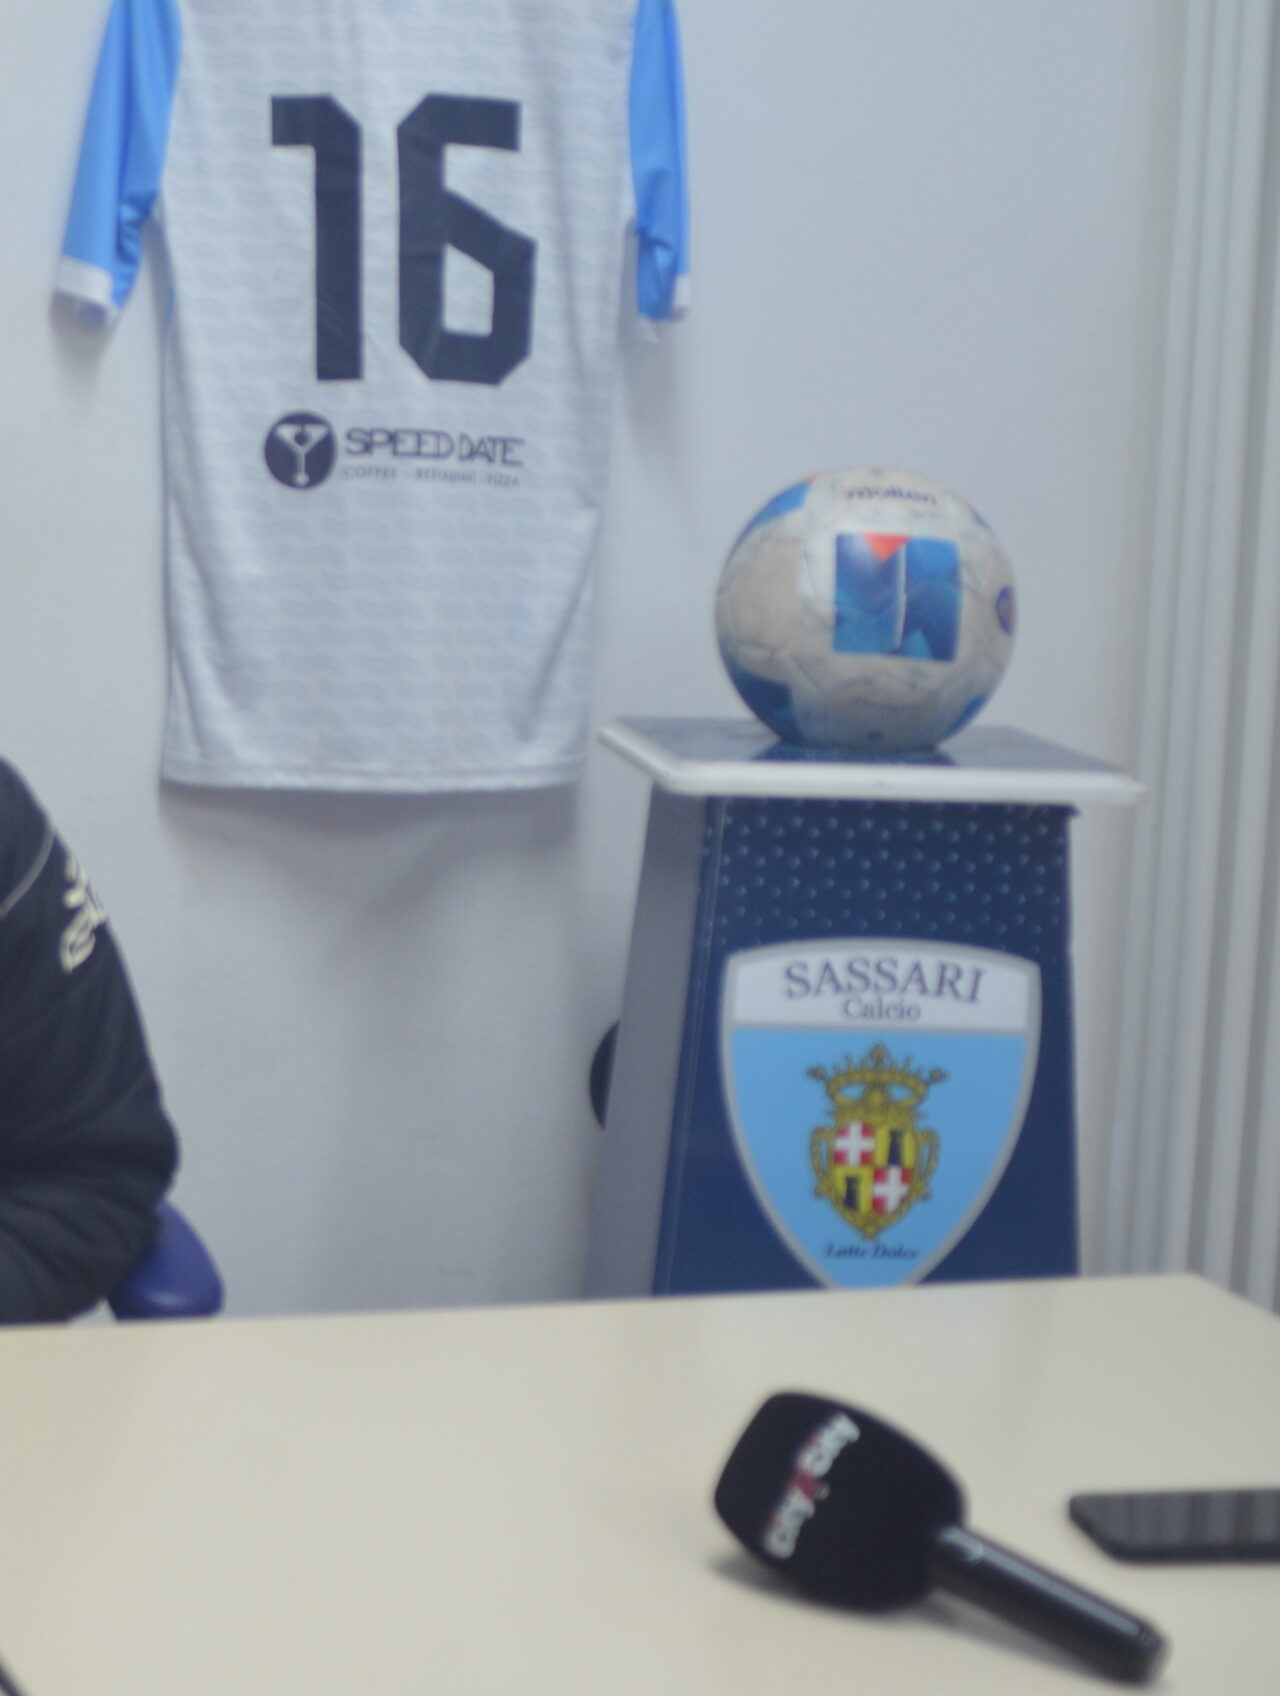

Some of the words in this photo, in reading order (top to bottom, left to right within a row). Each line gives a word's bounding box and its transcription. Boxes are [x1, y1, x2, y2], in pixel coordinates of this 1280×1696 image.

[271, 92, 538, 386] 16
[344, 427, 455, 460] SPEED
[458, 432, 526, 468] DATE
[784, 957, 988, 1006] SASSARI
[841, 996, 923, 1022] Calcio
